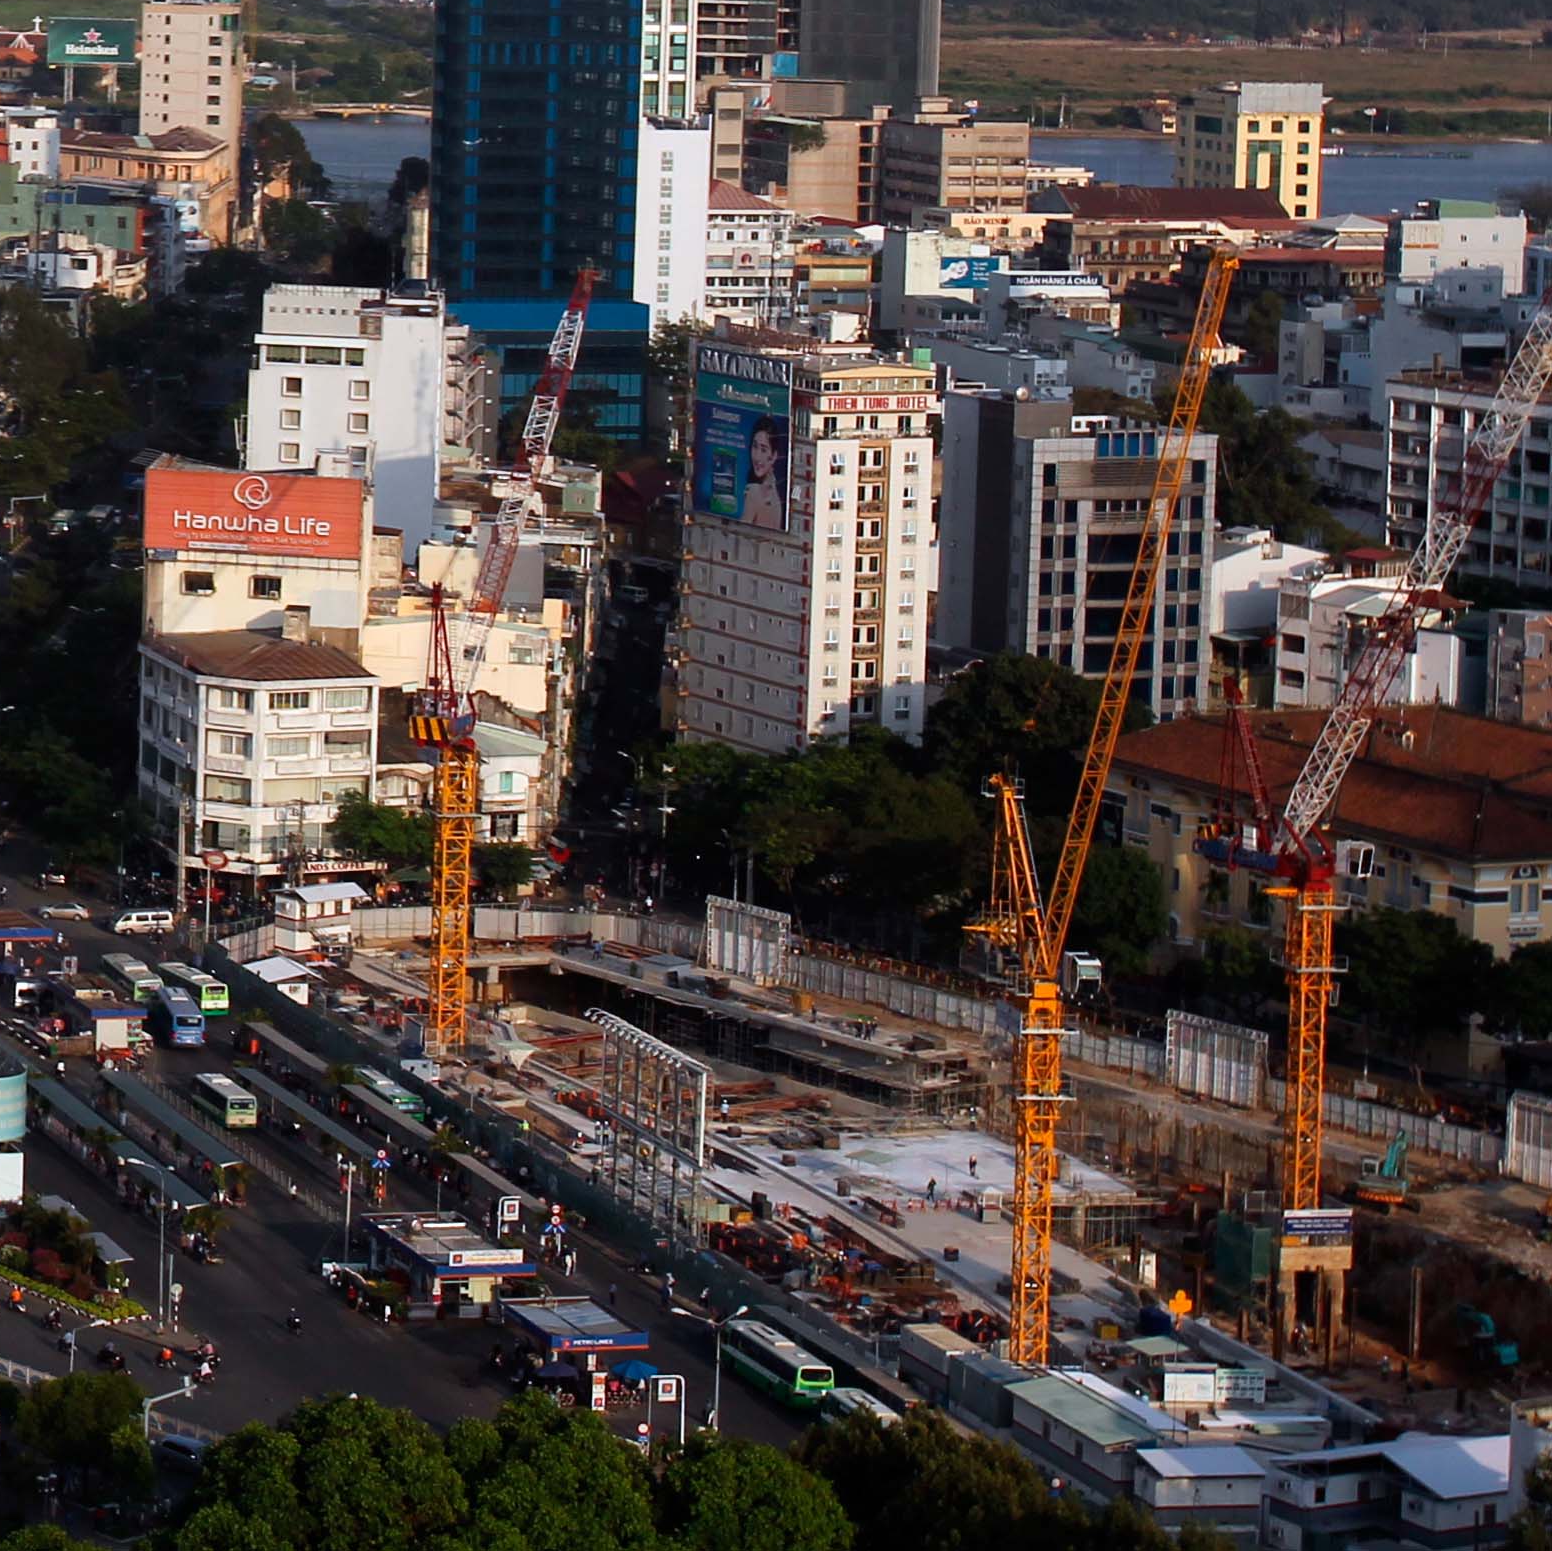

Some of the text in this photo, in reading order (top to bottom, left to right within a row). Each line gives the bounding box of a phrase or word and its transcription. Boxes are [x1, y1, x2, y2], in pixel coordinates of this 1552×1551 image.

[65, 43, 119, 56] Heineken
[897, 396, 931, 409] HOTEL
[173, 510, 331, 536] Hanwha Life
